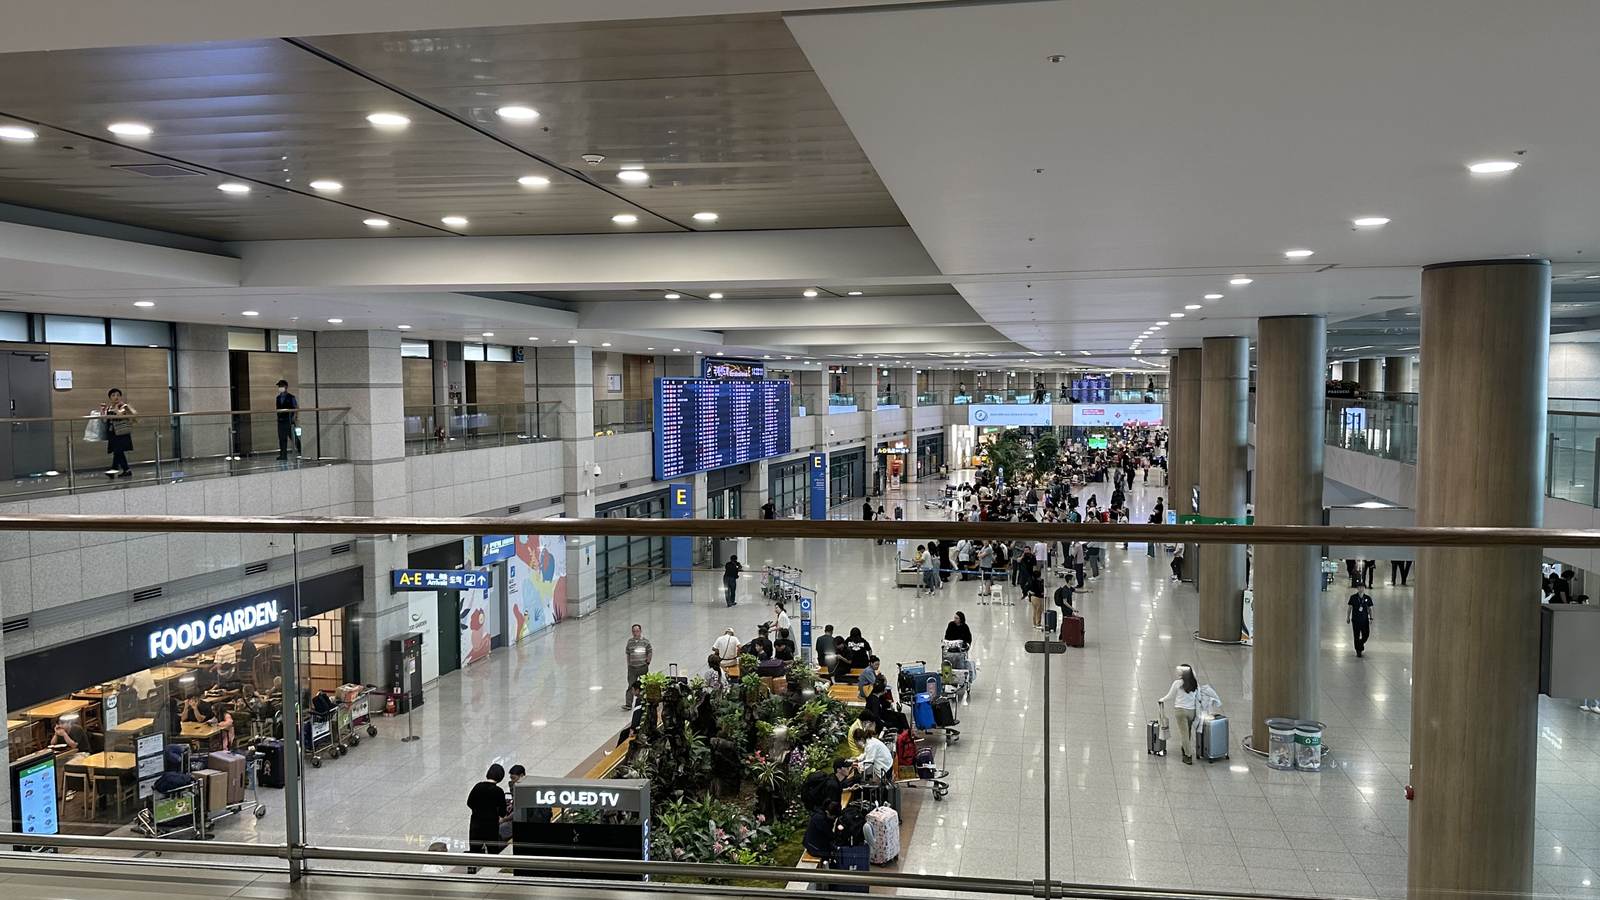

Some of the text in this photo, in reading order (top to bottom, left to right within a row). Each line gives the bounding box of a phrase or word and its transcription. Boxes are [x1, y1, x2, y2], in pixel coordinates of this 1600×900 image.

[814, 456, 822, 468] E
[676, 488, 687, 505] E
[399, 572, 422, 586] A-E
[149, 599, 278, 659] FOOD GARDEN
[536, 790, 620, 807] LG OLED TV
